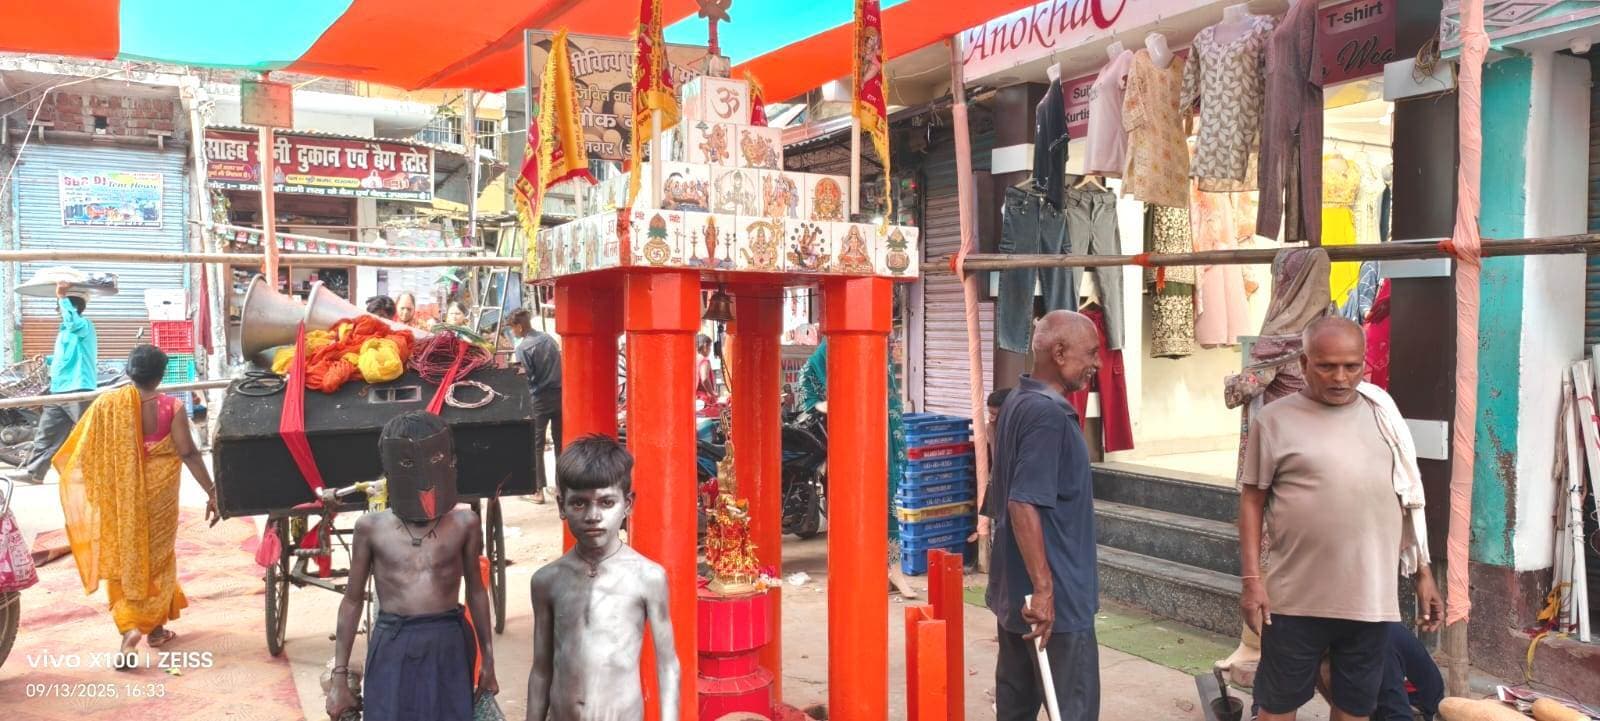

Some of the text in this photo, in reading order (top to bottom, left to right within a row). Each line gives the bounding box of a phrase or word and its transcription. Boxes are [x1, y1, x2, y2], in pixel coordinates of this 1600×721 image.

[1325, 4, 1384, 28] T-shirt
[963, 0, 1092, 66] Anokha
[1337, 35, 1395, 73] Wea
[1072, 84, 1093, 100] Sui
[296, 143, 341, 173] दुकान
[344, 142, 370, 170] एवं
[371, 143, 397, 172] बैग
[400, 147, 429, 173] स्टोर
